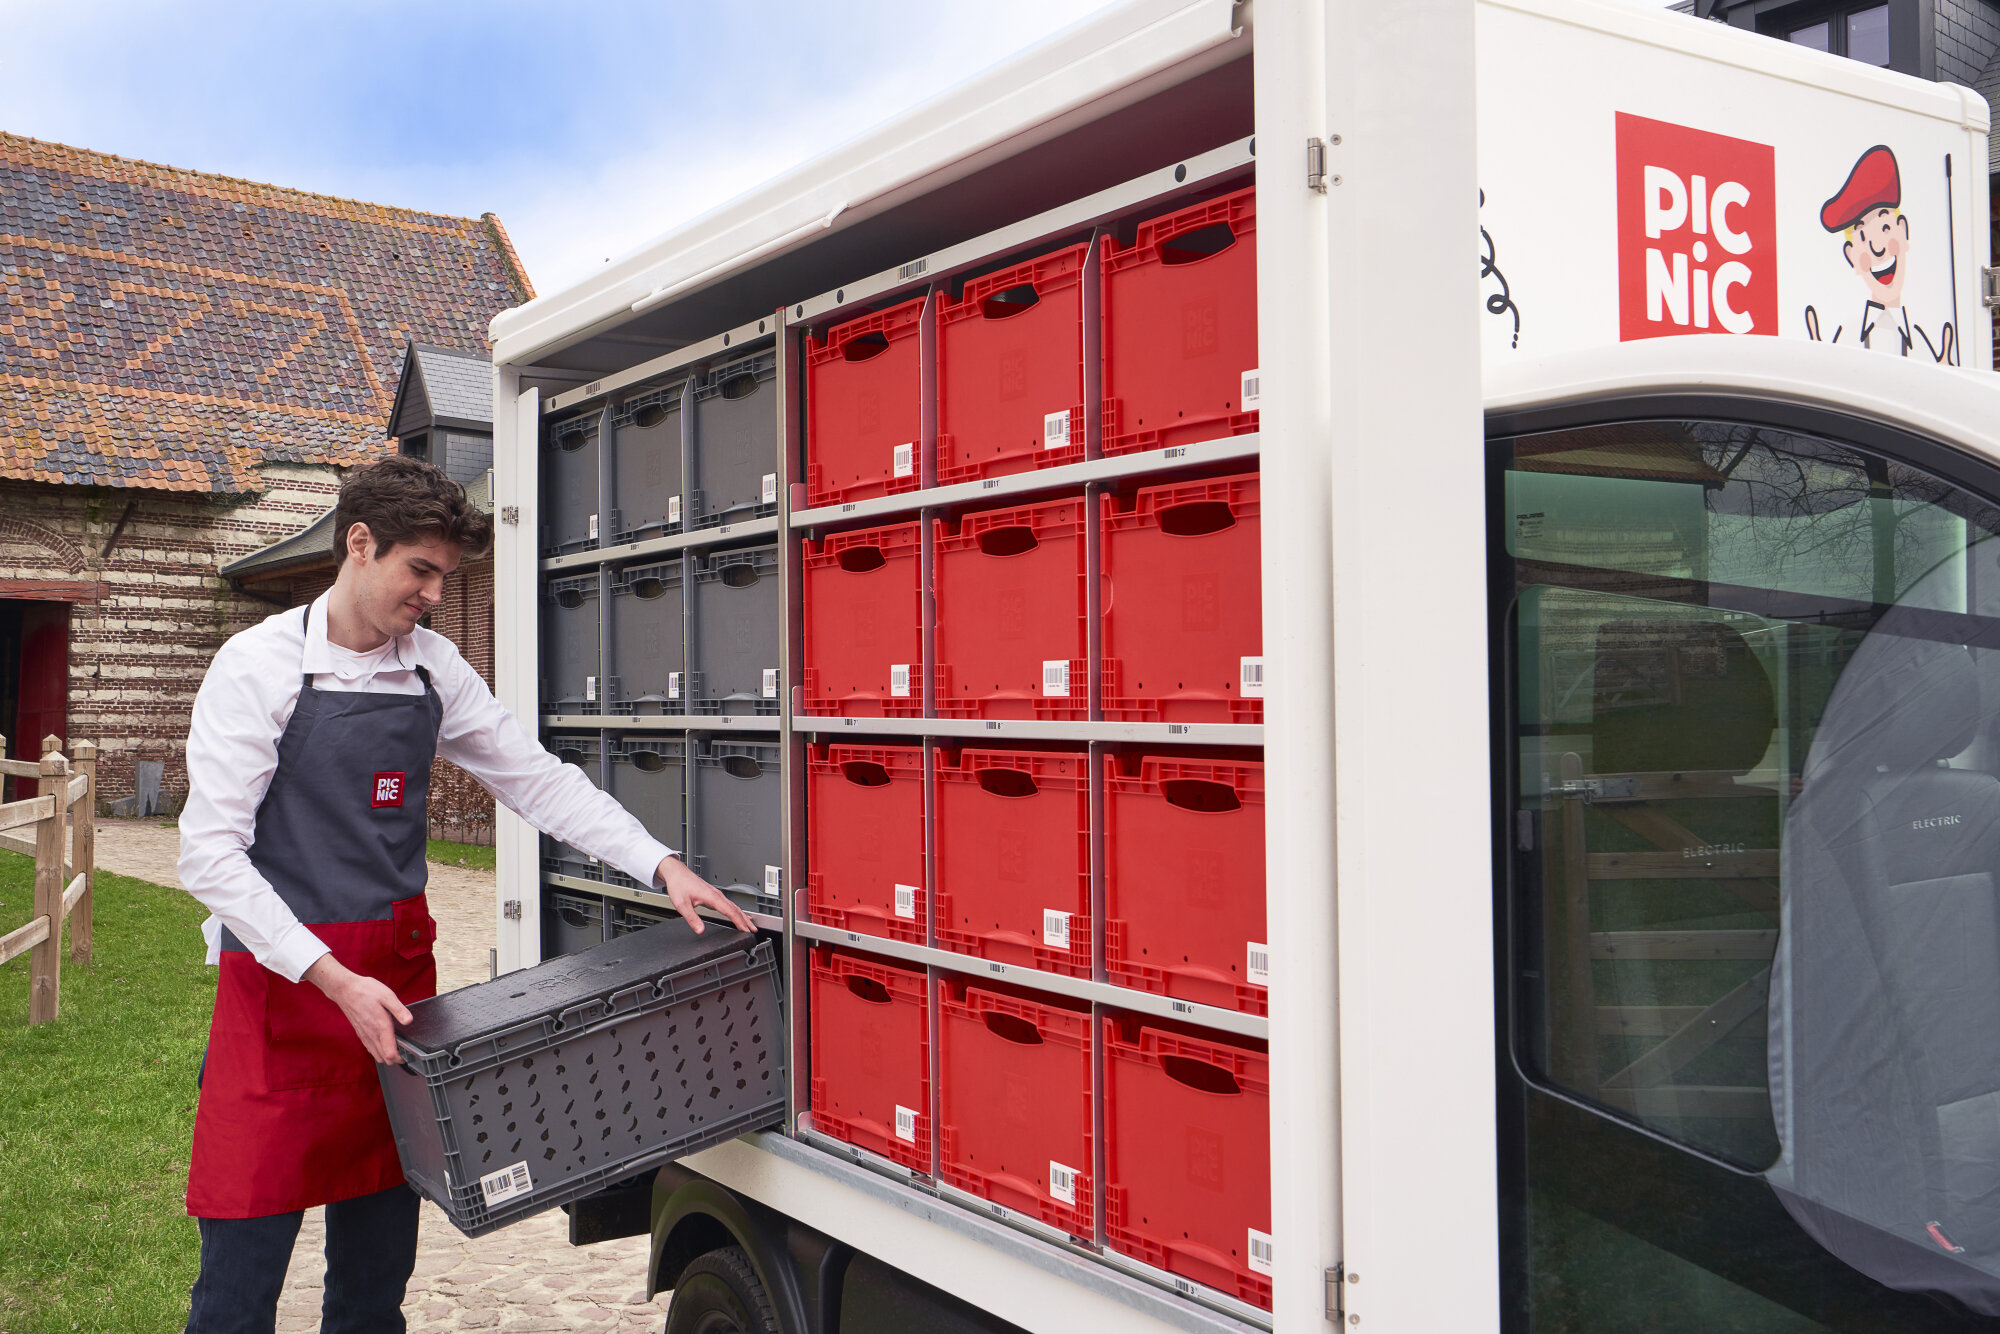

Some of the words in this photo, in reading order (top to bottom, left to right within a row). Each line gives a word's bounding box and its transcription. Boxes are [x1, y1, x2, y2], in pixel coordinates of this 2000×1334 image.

[1644, 165, 1753, 255] PIC
[1178, 448, 1185, 456] 12
[1059, 509, 1066, 522] C
[902, 531, 908, 542] C
[1059, 760, 1066, 773] C
[377, 778, 400, 790] PIC
[1912, 814, 1962, 830] ELECTRIC
[1683, 842, 1745, 858] ELECTRIC
[703, 967, 711, 979] A
[1187, 1006, 1192, 1014] 6
[497, 1036, 507, 1047] C
